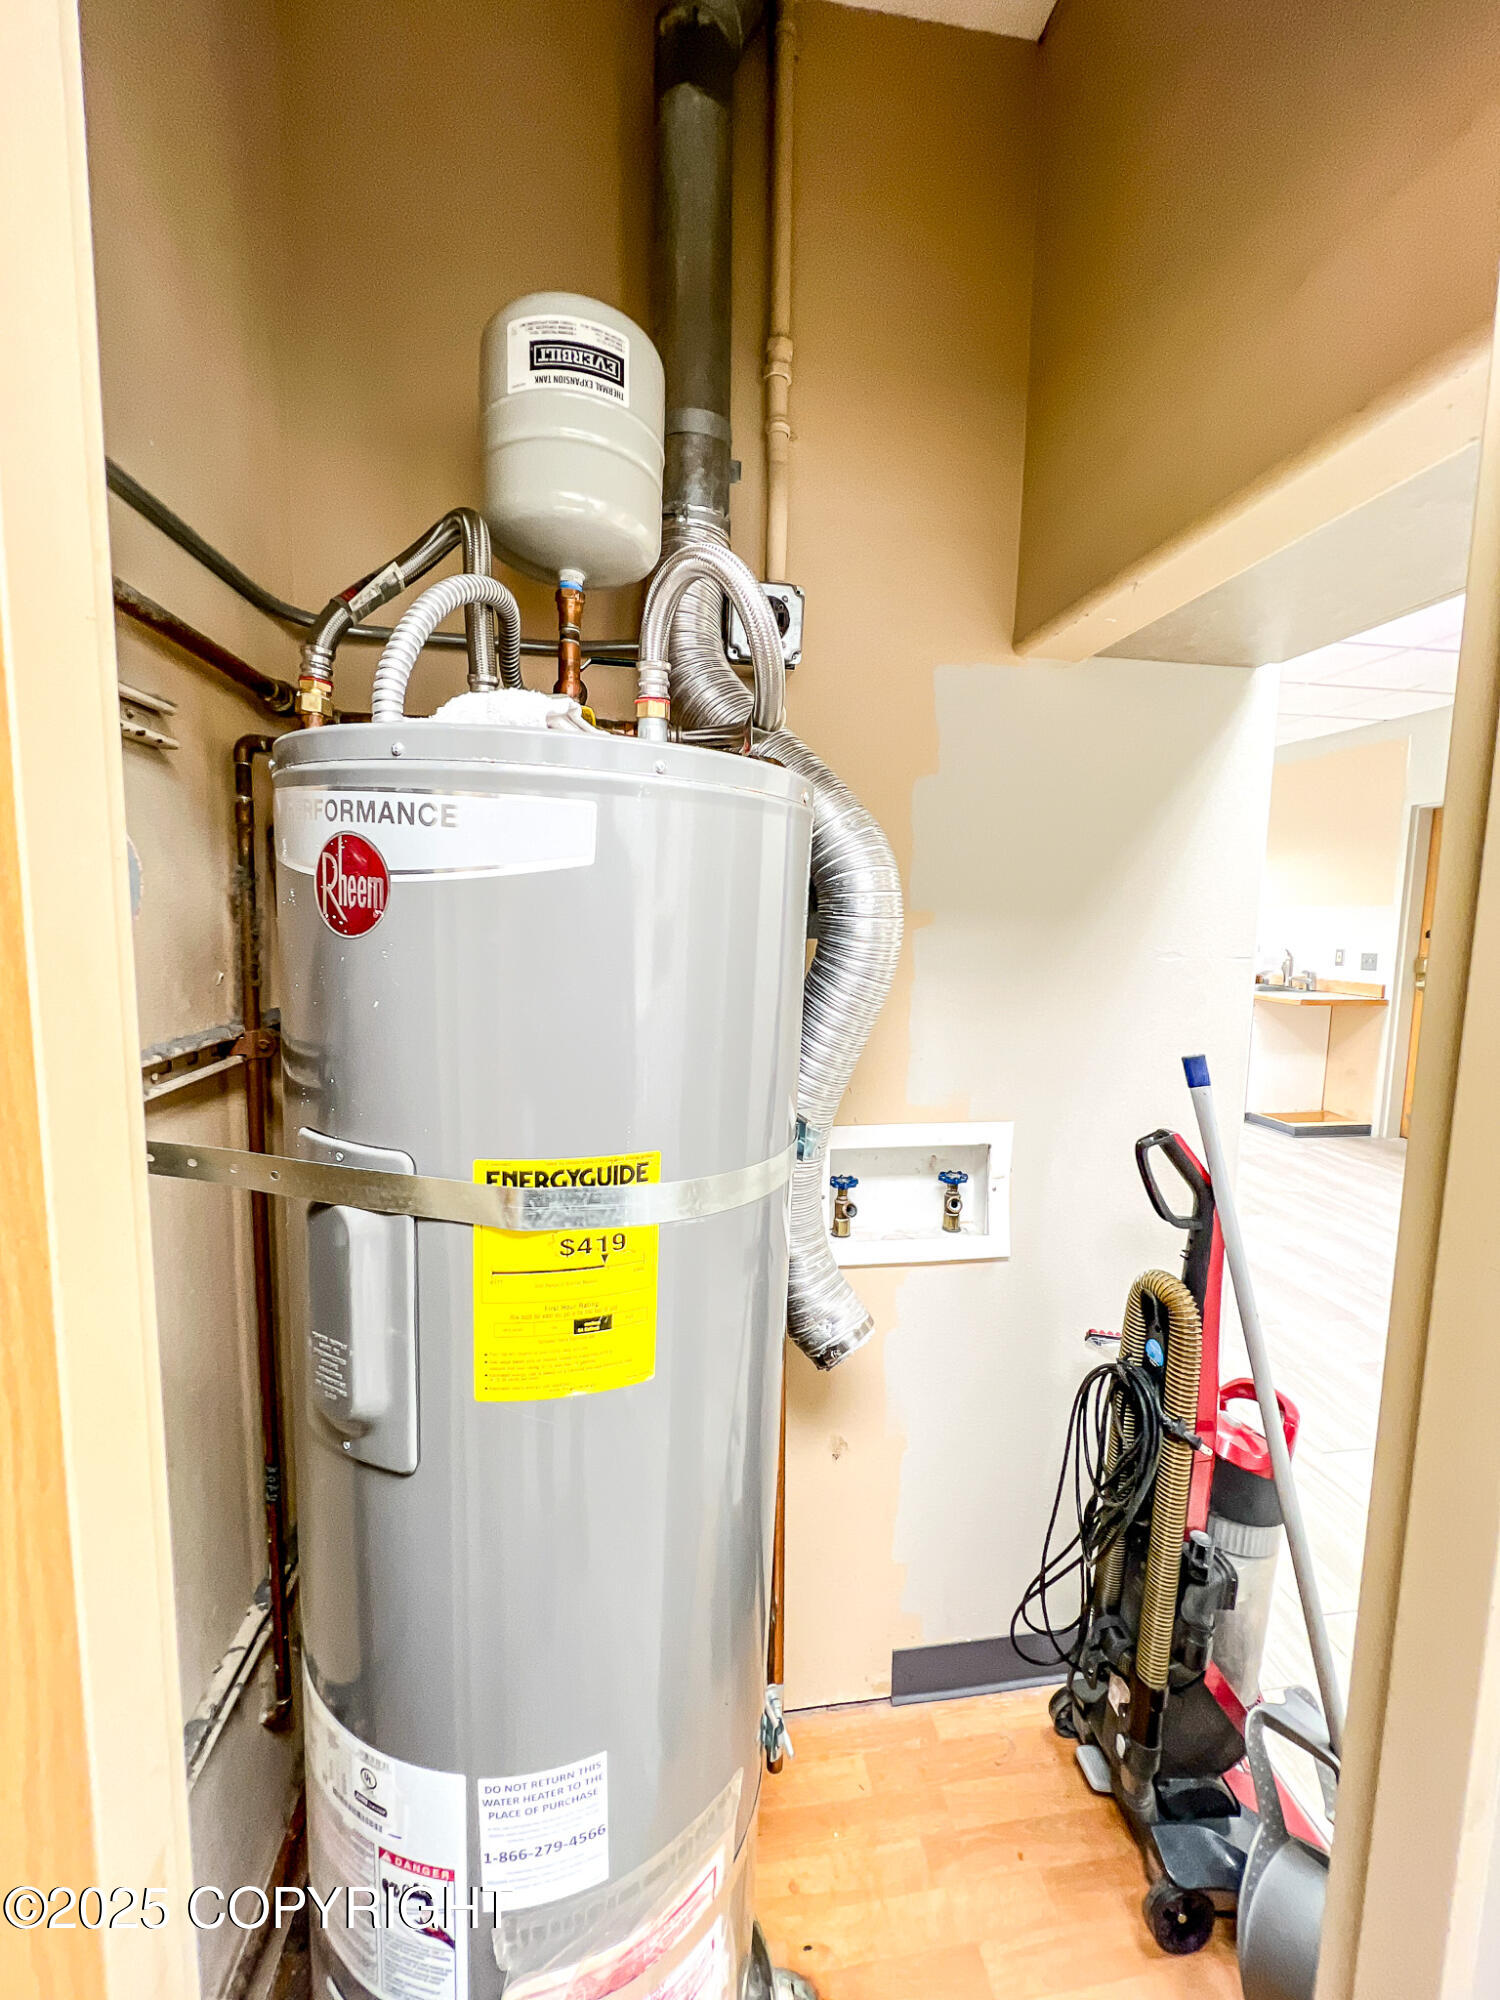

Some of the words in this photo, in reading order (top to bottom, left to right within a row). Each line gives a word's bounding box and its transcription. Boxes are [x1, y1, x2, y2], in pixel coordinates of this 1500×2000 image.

[537, 348, 618, 376] EVERBILT
[534, 374, 552, 385] TANK
[553, 375, 594, 389] EXPANSION
[595, 382, 625, 401] THERMAL
[321, 835, 384, 923] Rheem
[486, 1162, 649, 1188] ENERGYGUIDE
[559, 1233, 627, 1258] $419
[482, 1796, 520, 1807] WATER
[522, 1787, 564, 1803] HEATER
[568, 1781, 581, 1792] TO
[586, 1773, 603, 1785] THE
[484, 1785, 501, 1795] DO
[504, 1782, 528, 1793] NOT
[531, 1771, 575, 1788] RETURN
[579, 1761, 602, 1775] THIS
[488, 1809, 521, 1820] PLACE
[524, 1806, 539, 1816] OF
[542, 1788, 598, 1813] PURCHASE
[483, 1823, 607, 1865] 1-866-279-4566
[394, 1857, 450, 1880] DANGER
